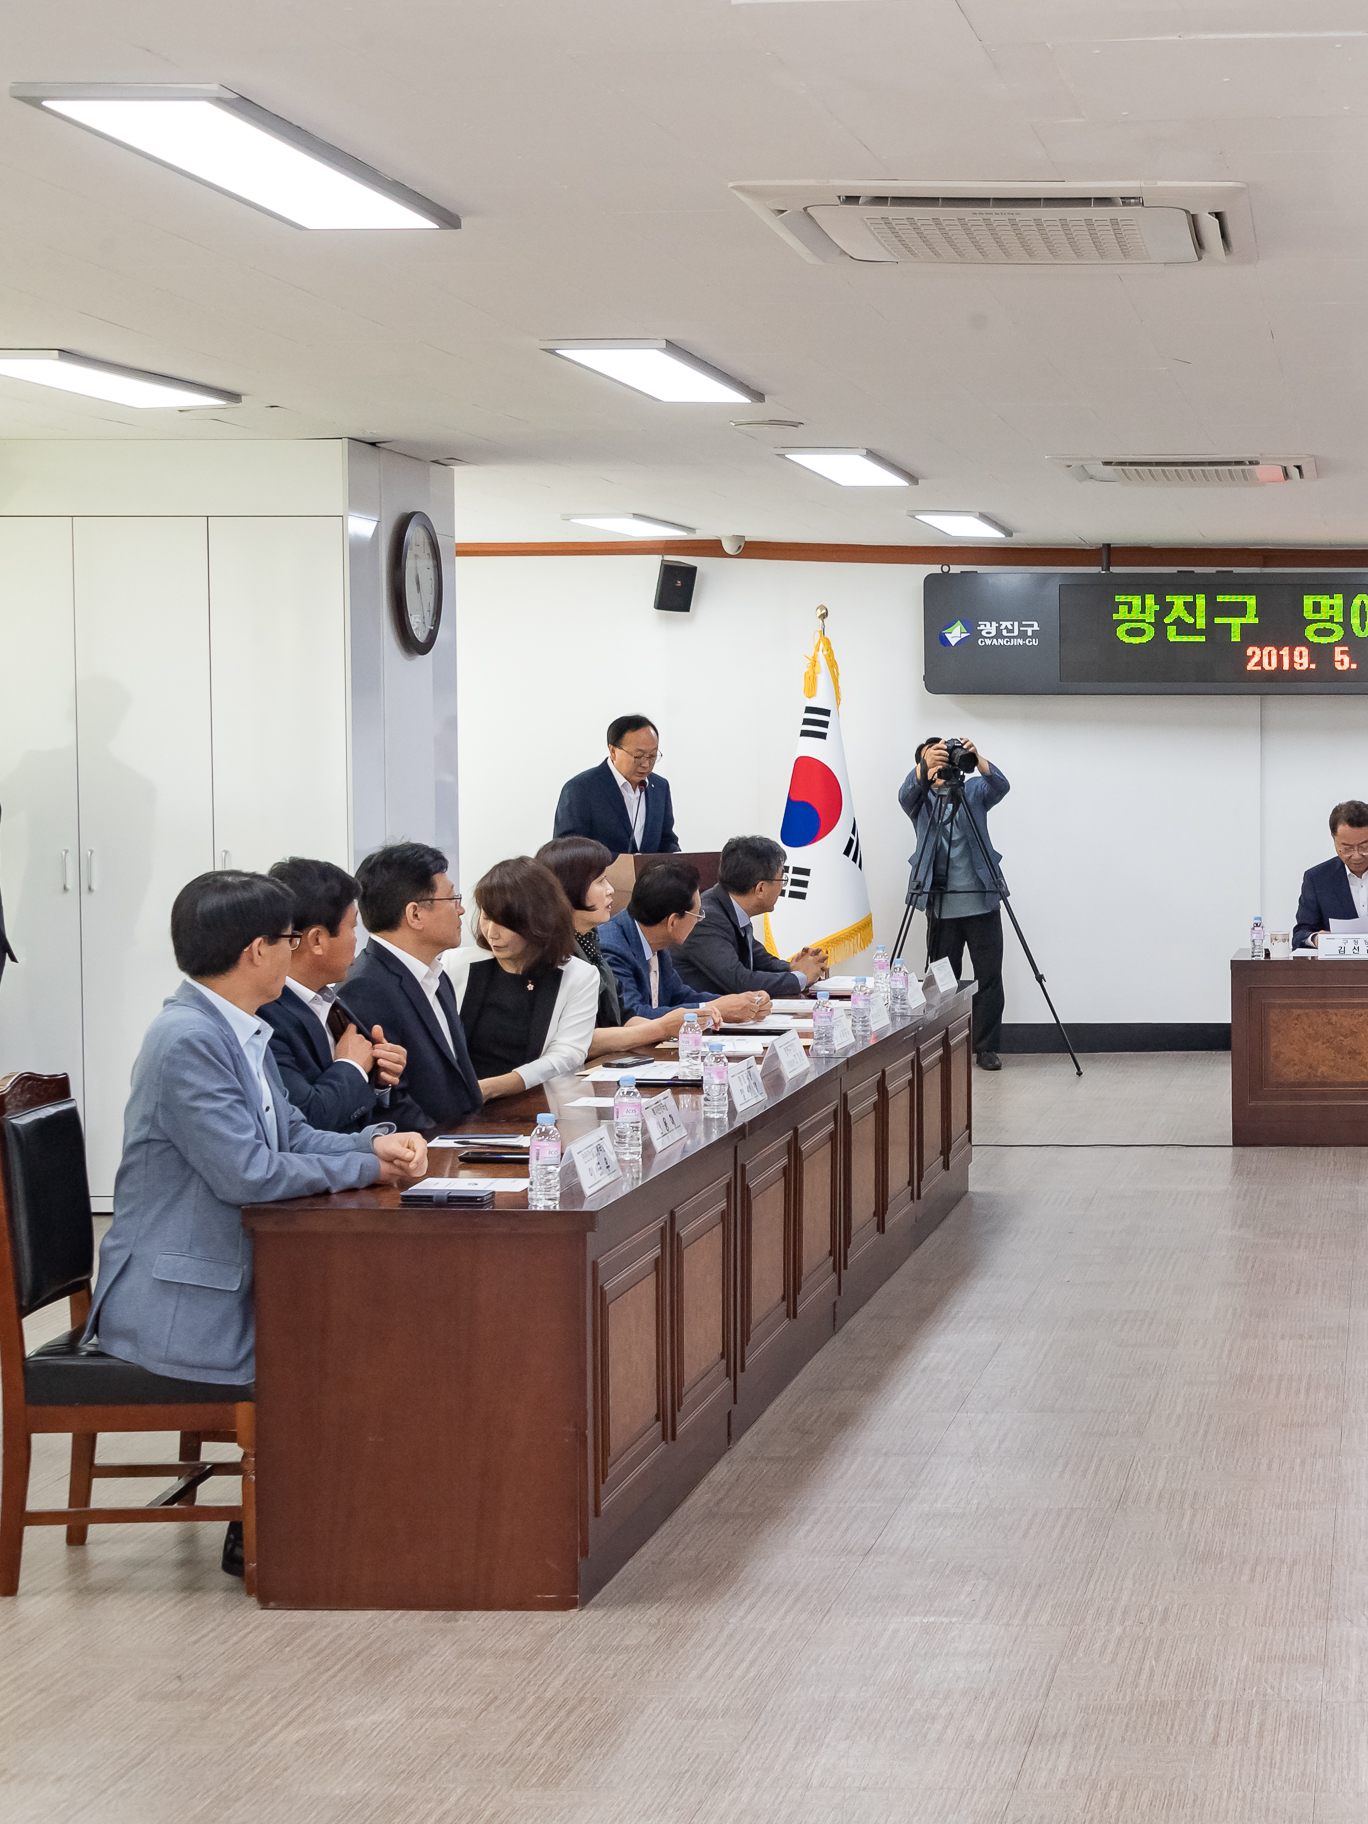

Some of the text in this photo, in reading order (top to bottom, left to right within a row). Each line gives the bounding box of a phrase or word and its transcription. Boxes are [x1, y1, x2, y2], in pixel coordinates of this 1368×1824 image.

[1112, 594, 1259, 643] 광진구
[977, 621, 1040, 637] 광진구
[978, 638, 1039, 646] GWANGJIN-GU
[1246, 646, 1317, 671] 2019.
[1333, 646, 1358, 671] 5.
